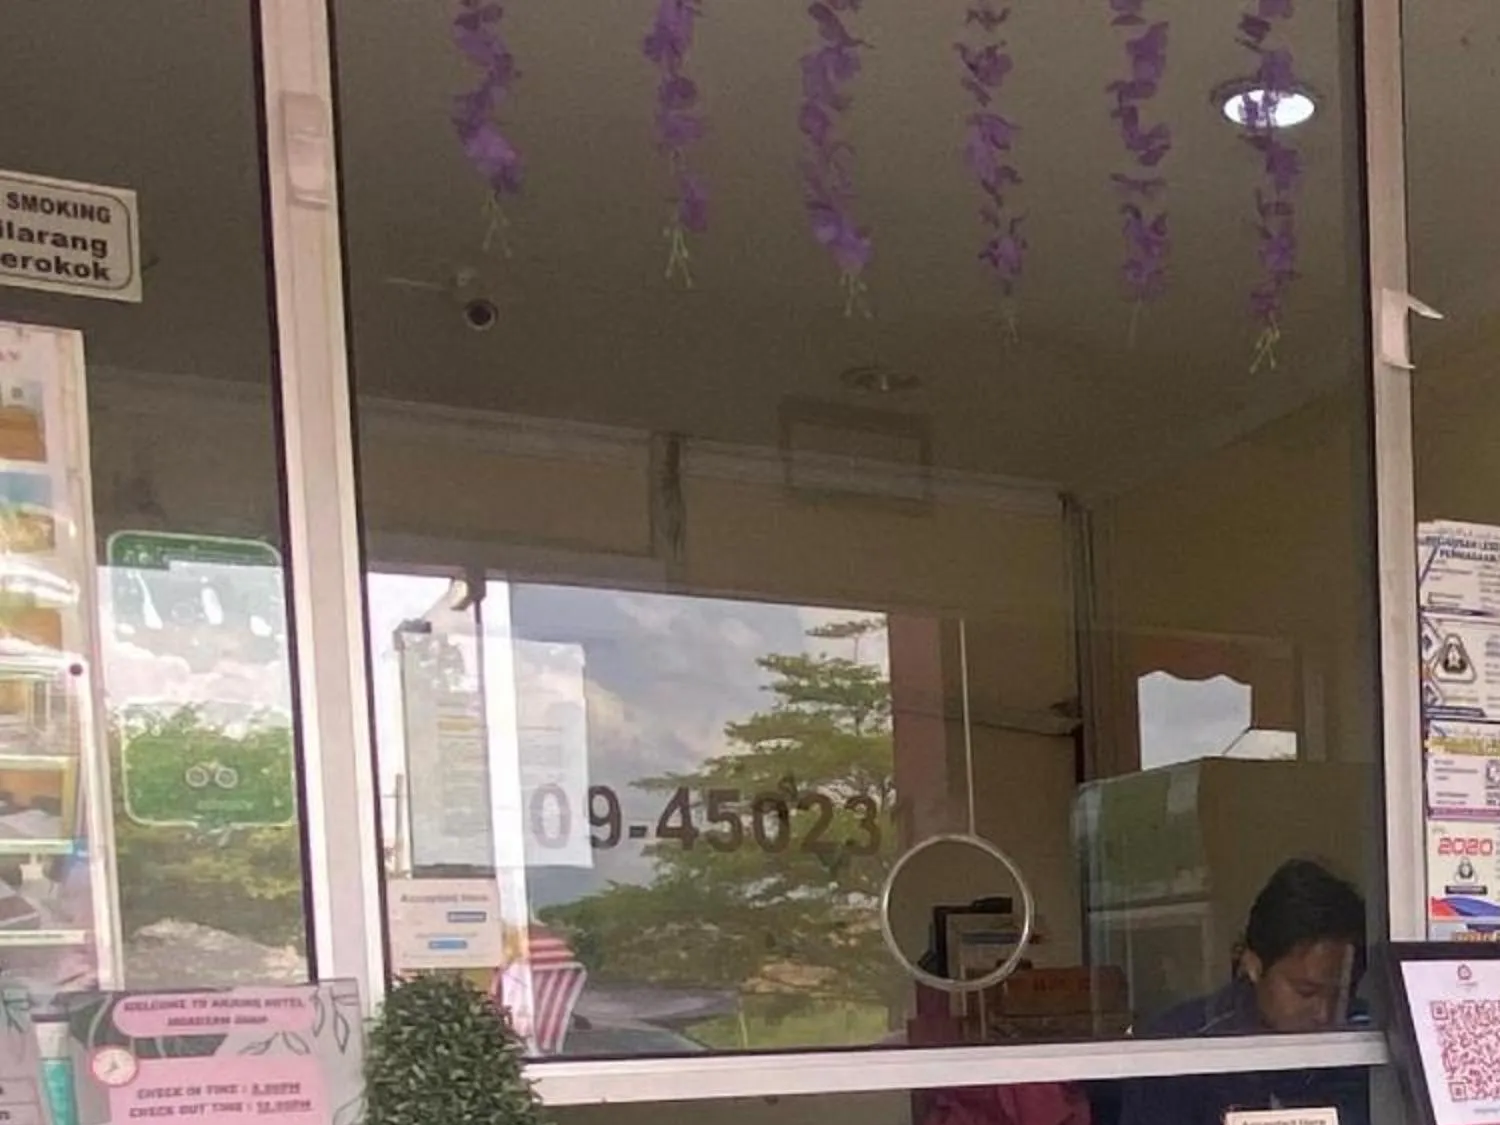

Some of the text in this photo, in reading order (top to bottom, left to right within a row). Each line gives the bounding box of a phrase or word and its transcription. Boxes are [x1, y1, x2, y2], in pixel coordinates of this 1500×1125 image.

[6, 191, 111, 224] SMOKING
[529, 783, 883, 857] 09-45023
[1438, 837, 1493, 856] 2020
